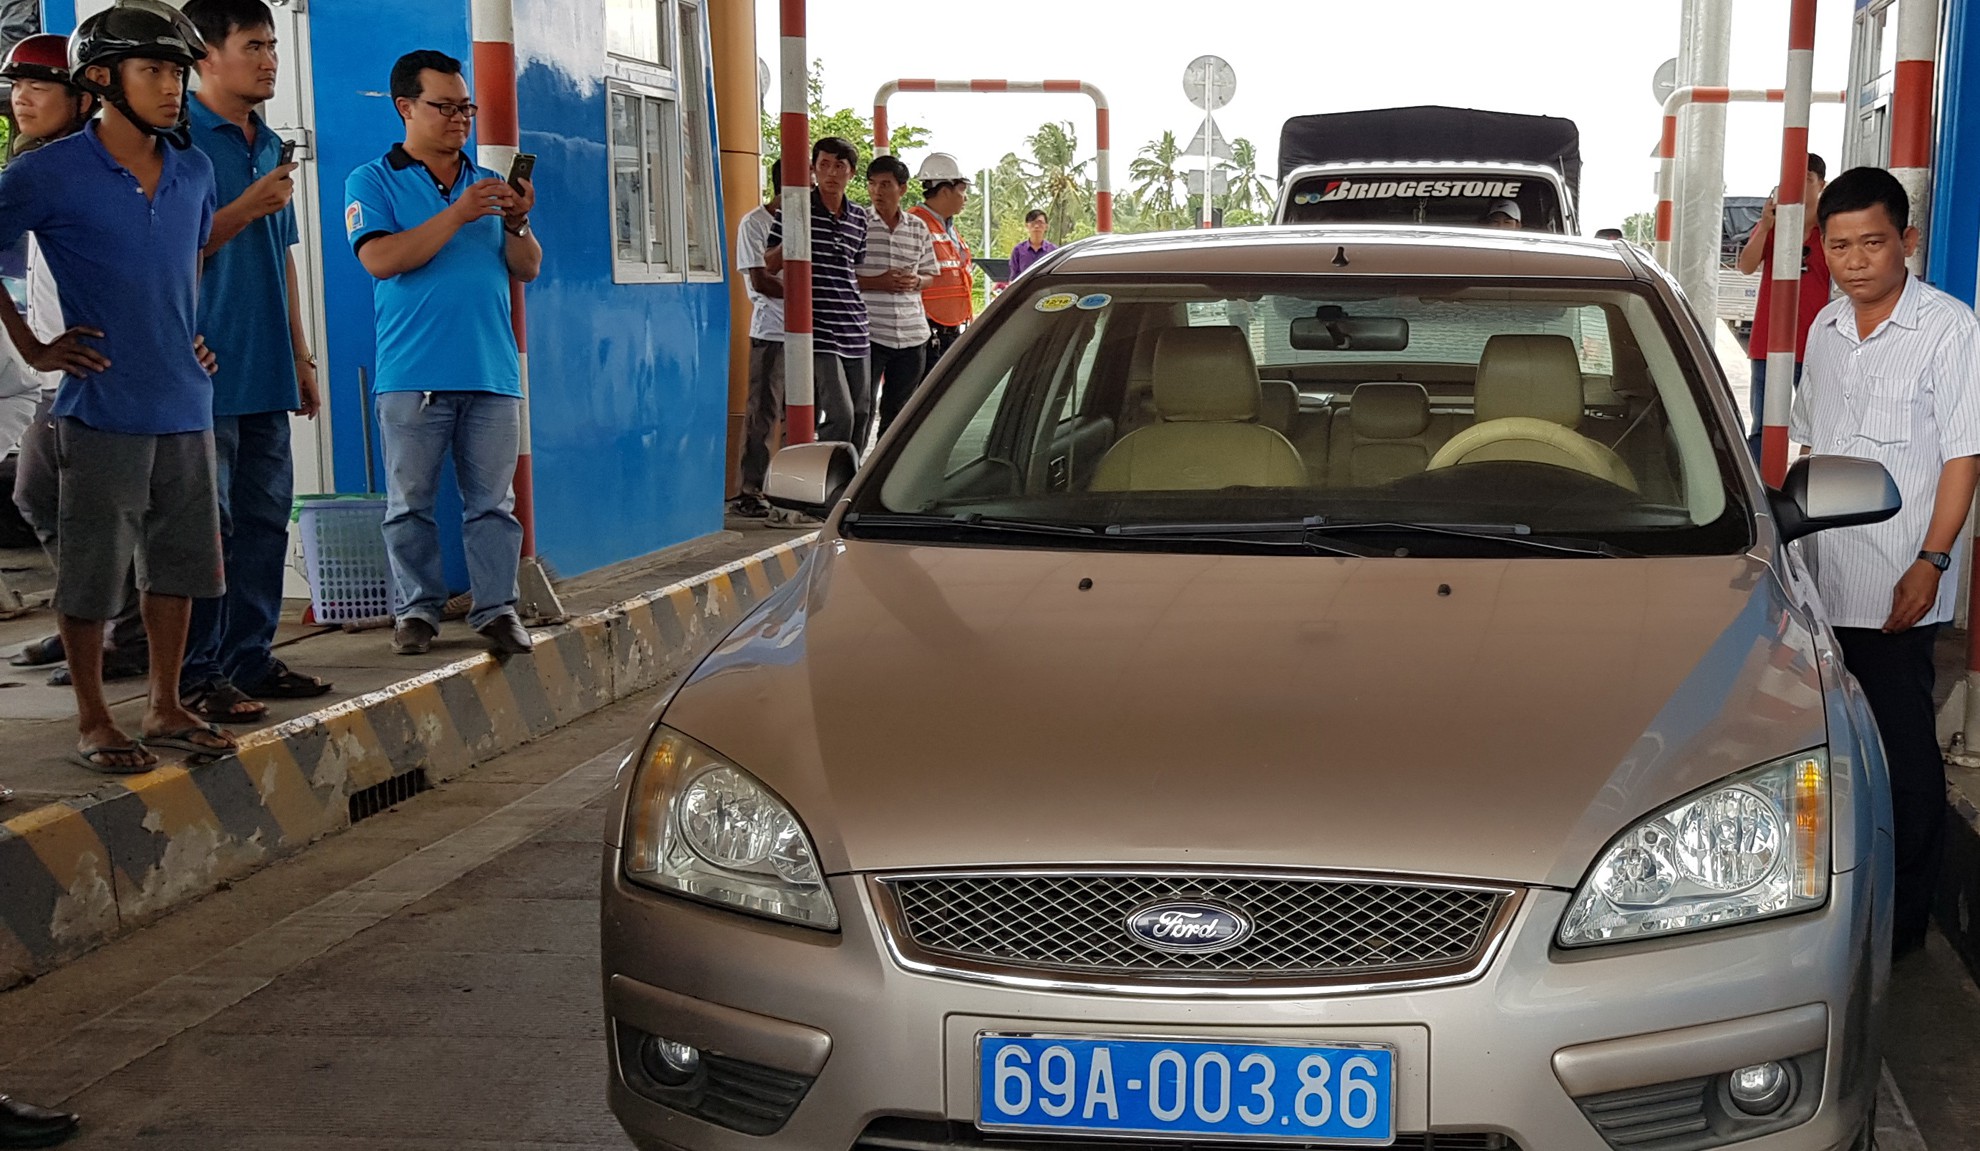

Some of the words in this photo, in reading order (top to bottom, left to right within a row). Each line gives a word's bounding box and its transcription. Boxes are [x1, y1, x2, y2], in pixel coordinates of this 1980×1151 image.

[1320, 181, 1522, 201] BRIDGESTONE
[1152, 910, 1219, 938] Ford
[994, 1044, 1378, 1129] 69A-003.86
